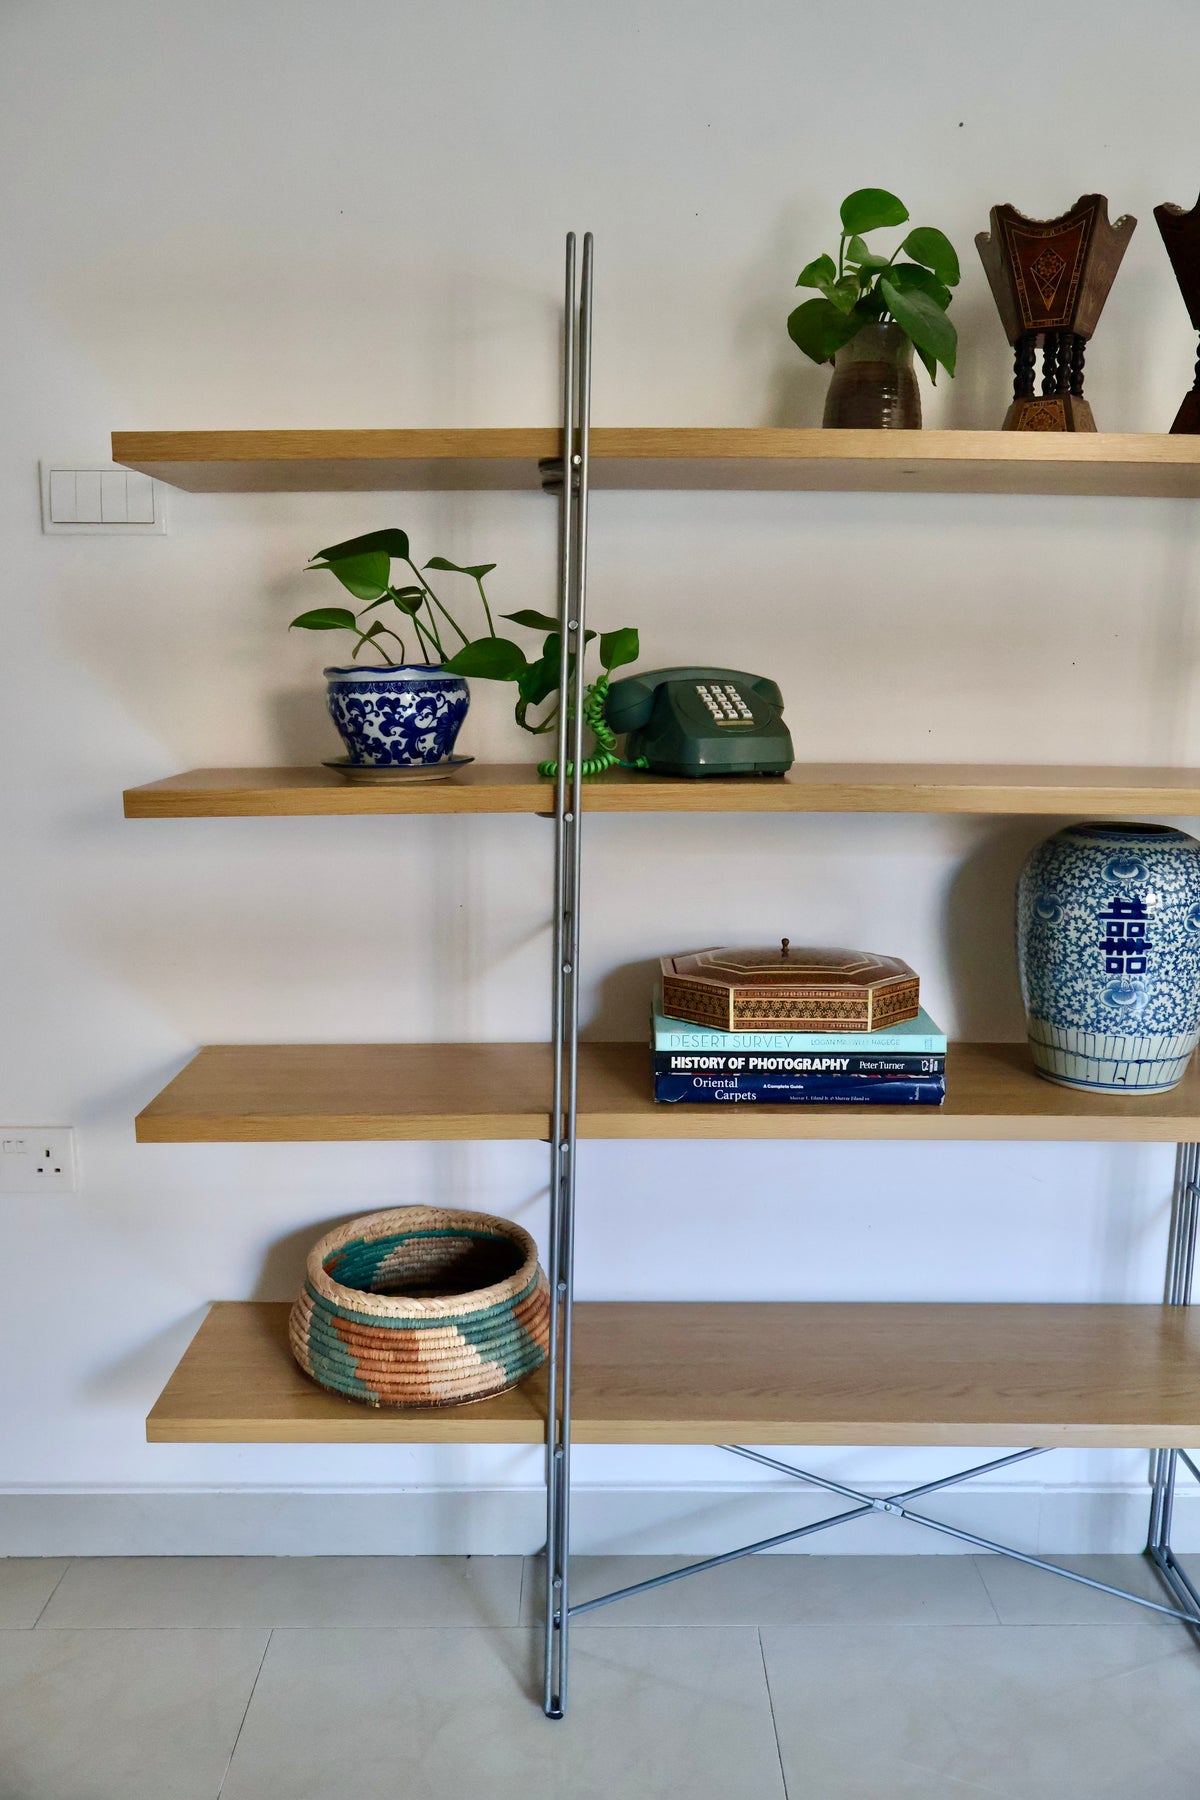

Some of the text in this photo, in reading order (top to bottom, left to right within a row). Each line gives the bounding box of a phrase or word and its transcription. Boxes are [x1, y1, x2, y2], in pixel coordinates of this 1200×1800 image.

[670, 1034, 793, 1049] DESERT SURVEY
[810, 1038, 836, 1046] LOGAN
[671, 1056, 850, 1071] HISTORY OF PHOTOGRAPHY
[859, 1060, 905, 1071] Peter Turner
[693, 1077, 738, 1088] Oriental
[714, 1089, 757, 1102] Carpets
